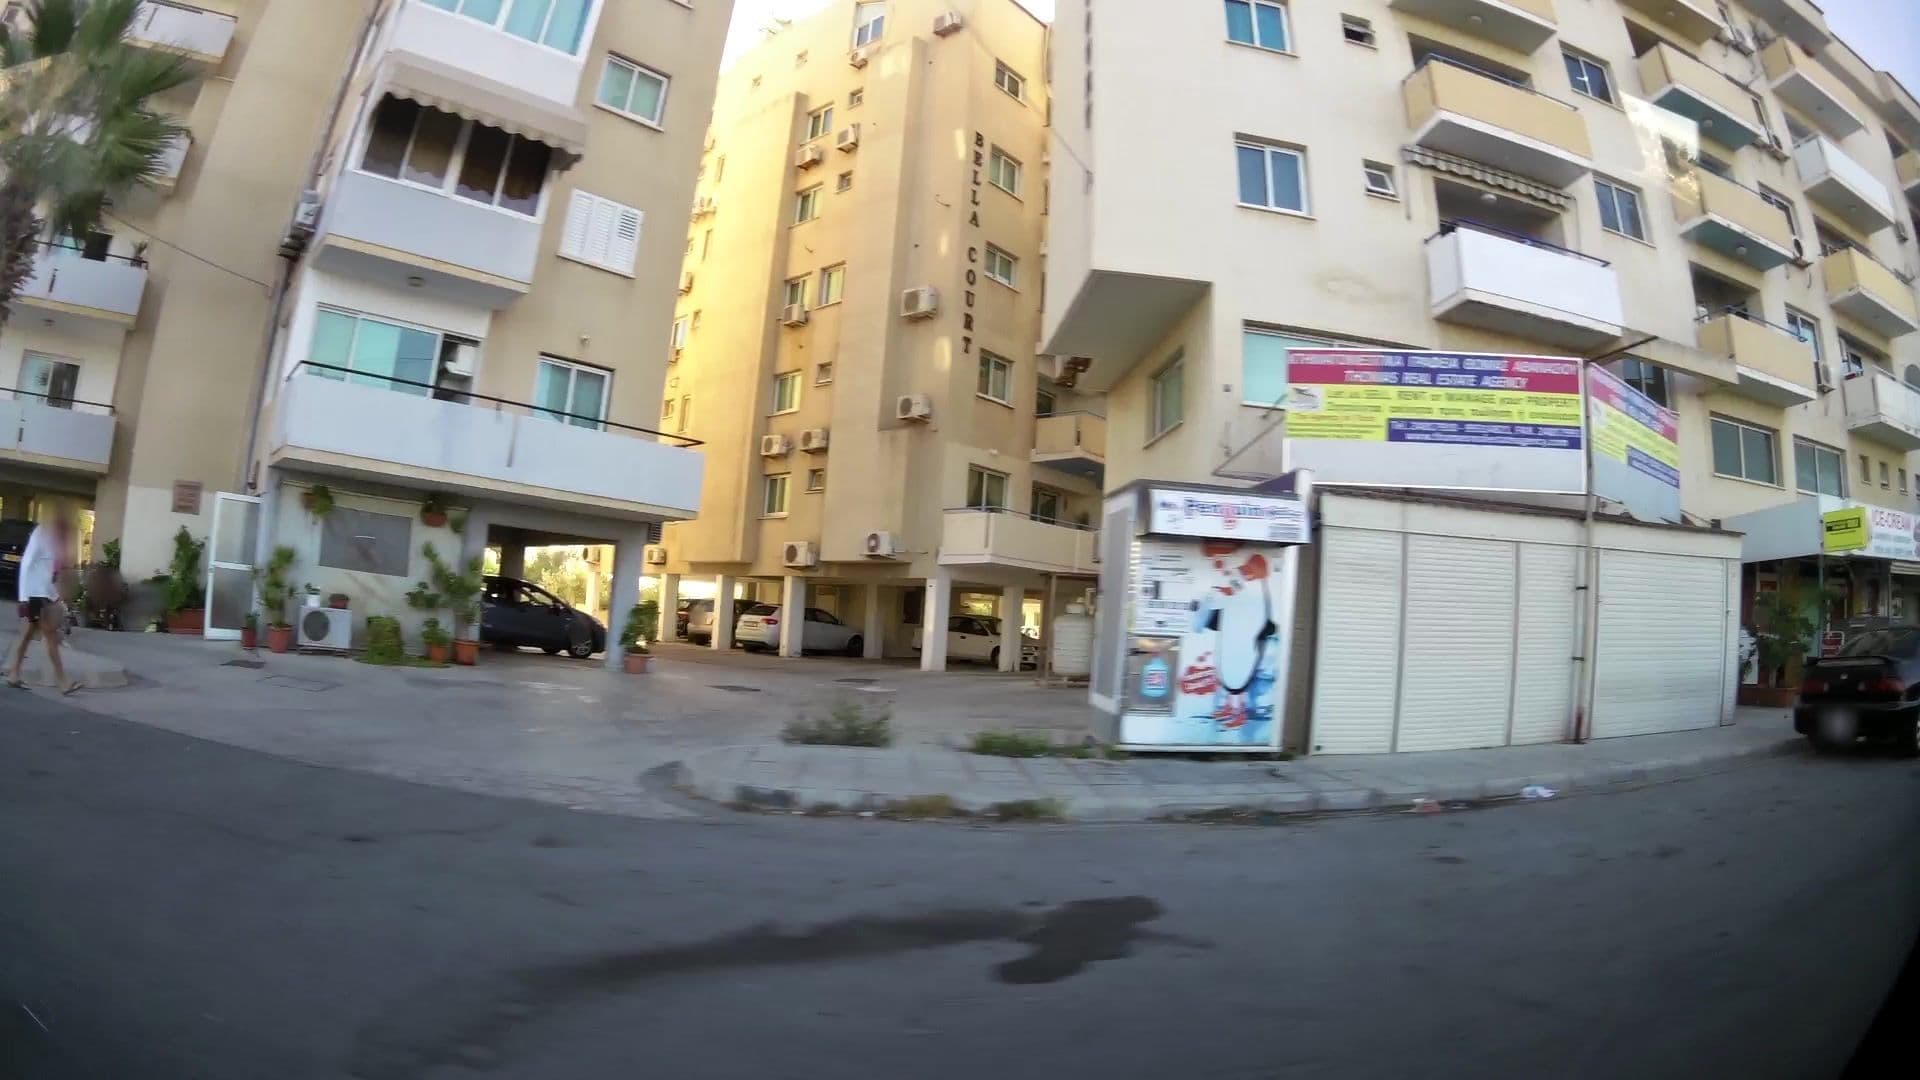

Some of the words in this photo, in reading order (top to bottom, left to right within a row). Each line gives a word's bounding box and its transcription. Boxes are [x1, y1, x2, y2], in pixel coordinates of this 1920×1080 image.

[968, 131, 984, 229] BELLA
[961, 246, 978, 354] COURT
[1344, 370, 1400, 384] THOMAS
[1401, 371, 1431, 385] REAL
[1435, 373, 1479, 386] ESTATE
[1480, 375, 1528, 389] AGENCY
